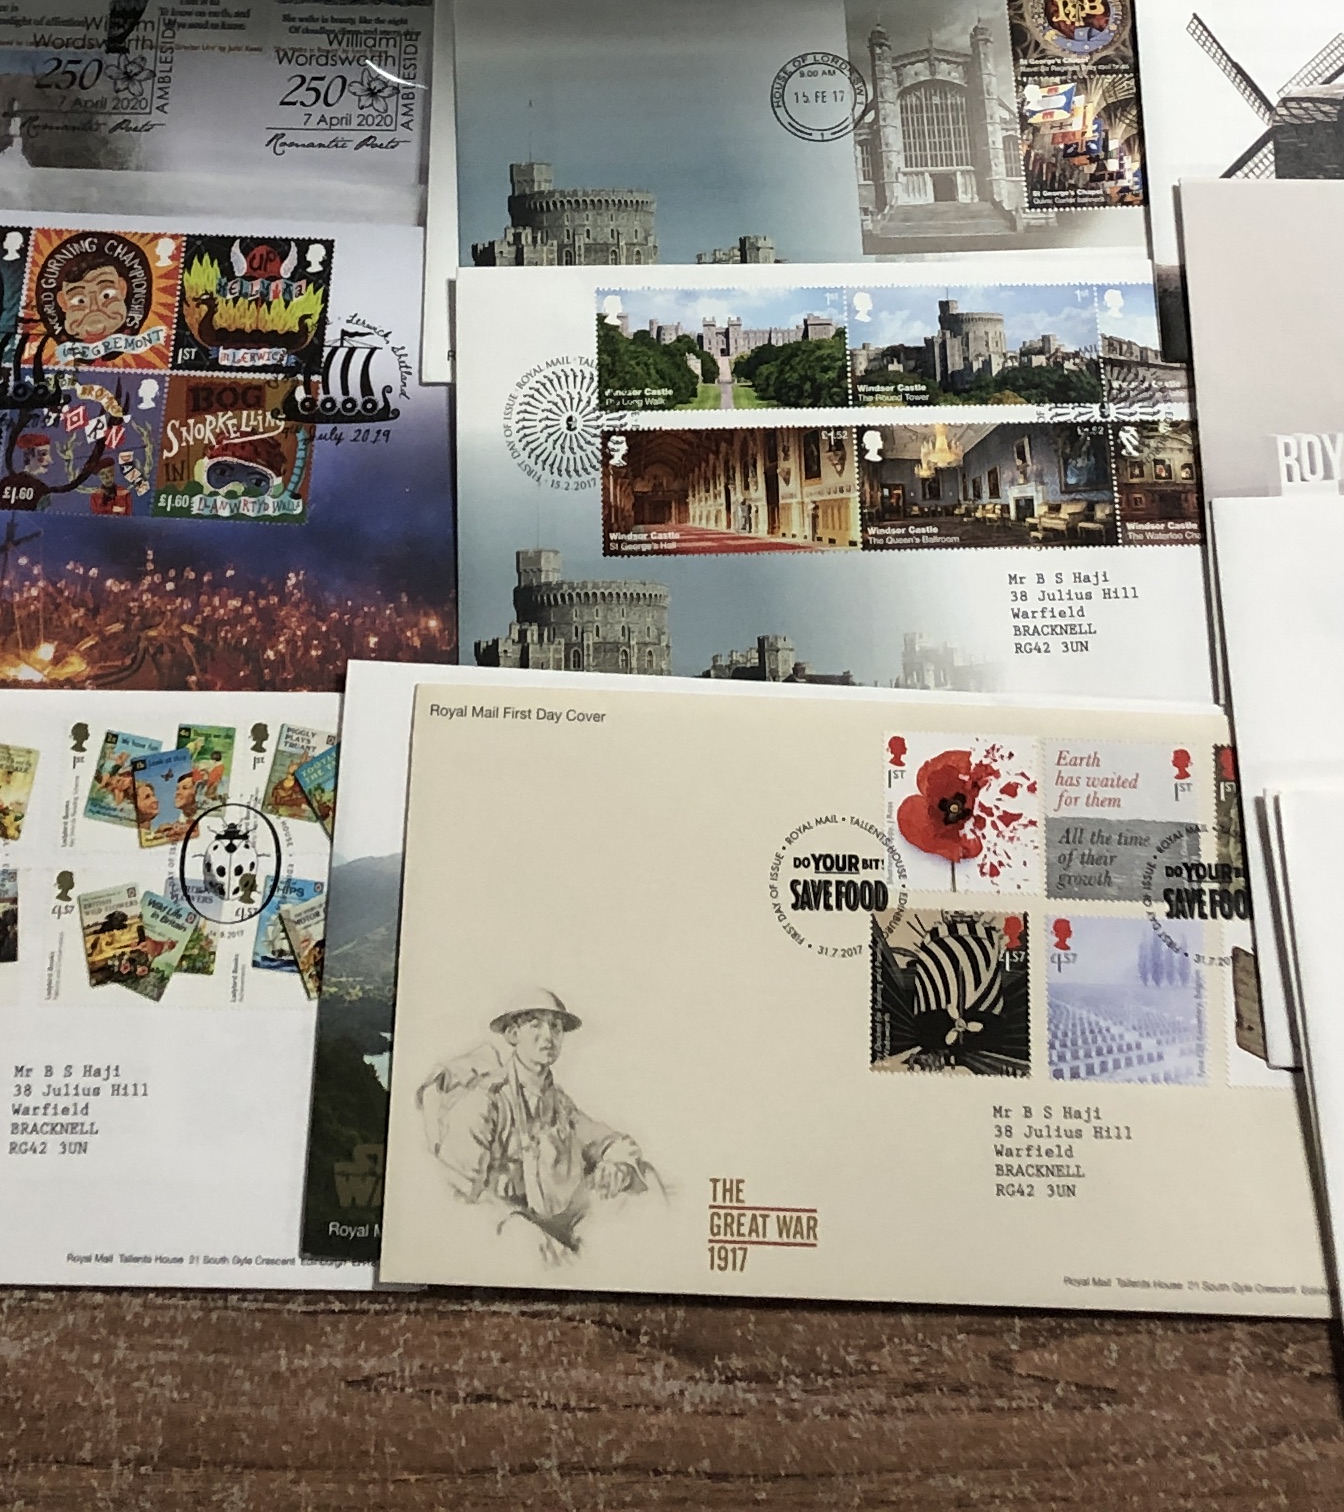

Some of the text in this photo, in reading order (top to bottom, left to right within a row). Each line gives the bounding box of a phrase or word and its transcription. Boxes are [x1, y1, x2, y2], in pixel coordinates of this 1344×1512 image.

[326, 33, 397, 49] William
[275, 48, 397, 68] Wordsworth
[34, 57, 104, 90] 250
[773, 55, 808, 108] HOUSE OF
[279, 73, 348, 107] 250
[814, 89, 845, 104] FE 17
[70, 96, 149, 114] April 2020
[303, 113, 394, 129] 7 April 2020
[265, 132, 354, 156] Romantic
[41, 237, 150, 330] GURNING CHAMPIONSHIPS
[177, 347, 198, 364] 1ST
[503, 355, 572, 422] ISSUE ROYAL MAIL
[644, 386, 674, 396] Castle
[856, 383, 927, 393] Windsor Castle
[905, 392, 930, 401] Tower
[189, 385, 264, 412] BOG
[348, 428, 392, 445] 2019
[821, 430, 849, 445] £1.52
[164, 460, 186, 482] IN
[2, 487, 34, 504] £1.60
[158, 494, 189, 511] £1.60
[867, 524, 939, 535] Windsor Castle
[1126, 521, 1198, 531] Windsor Castle
[609, 531, 680, 541] Windsor Castle
[868, 534, 960, 546] The Queen's Ballroom
[1127, 531, 1144, 541] The
[1008, 570, 1110, 586] Mr B S Haji
[1010, 586, 1139, 602] 38 Julius Hill
[1011, 605, 1086, 619] Warfield
[1013, 622, 1097, 637] BRACKNELL
[1014, 640, 1089, 654] RG42 3UN
[429, 703, 606, 724] Royal Mail First Day Cover
[286, 726, 318, 739] PIGGLY
[1055, 749, 1101, 769] Earth
[887, 768, 906, 789] 1ST
[1055, 770, 1139, 790] has waited
[1173, 782, 1193, 802] 1ST
[1053, 791, 1122, 812] for them
[1057, 827, 1151, 848] All the time
[793, 853, 885, 871] DO YOUR BIT!
[1057, 848, 1118, 869] of their
[769, 814, 839, 945] FIRST DAY OF ISSUE ROYAL MAIL
[1056, 870, 1113, 891] growth
[1165, 862, 1232, 882] DO YOUR
[789, 879, 889, 913] SAVE FOOD
[1163, 888, 1208, 920] SAVE
[999, 950, 1026, 972] £1.57
[13, 1065, 121, 1081] Mr B S Haji
[13, 1083, 149, 1097] 38 Julius Hill
[11, 1102, 90, 1116] Warfield
[992, 1106, 1102, 1123] Mr B S Haji
[10, 1121, 99, 1136] BRACKNELL
[994, 1124, 1132, 1140] 38 Julius Hill
[8, 1140, 88, 1155] RG42 3UN
[994, 1144, 1074, 1158] Warfield
[995, 1163, 1086, 1178] BRACKNELL
[709, 1177, 745, 1203] THE
[995, 1183, 1077, 1197] RG42 3UN
[328, 1221, 369, 1240] Royal
[709, 1211, 818, 1241] GREAT WAR
[708, 1245, 748, 1272] 1917
